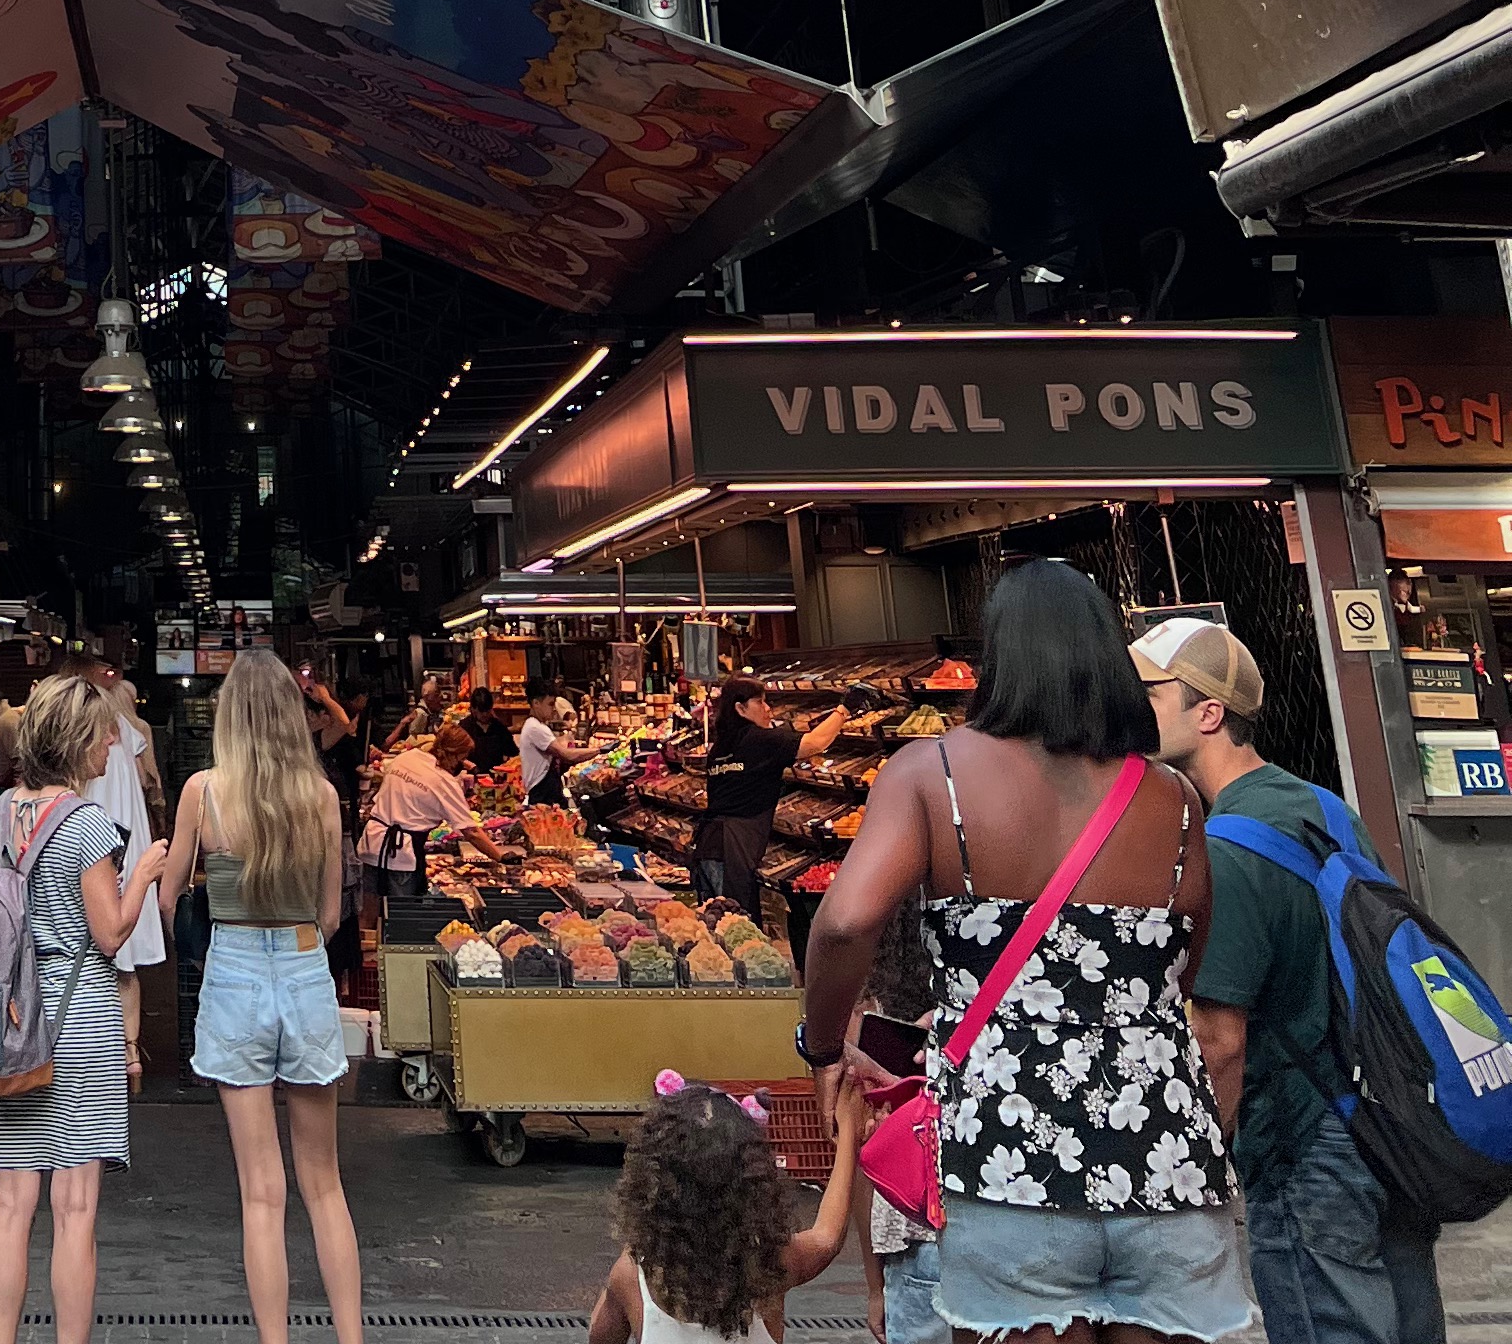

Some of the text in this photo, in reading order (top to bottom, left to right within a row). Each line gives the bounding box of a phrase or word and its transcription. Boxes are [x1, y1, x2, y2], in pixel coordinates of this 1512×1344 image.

[765, 381, 1257, 434] VIDAL PONS
[1375, 376, 1512, 450] PiN
[1460, 762, 1504, 789] RB
